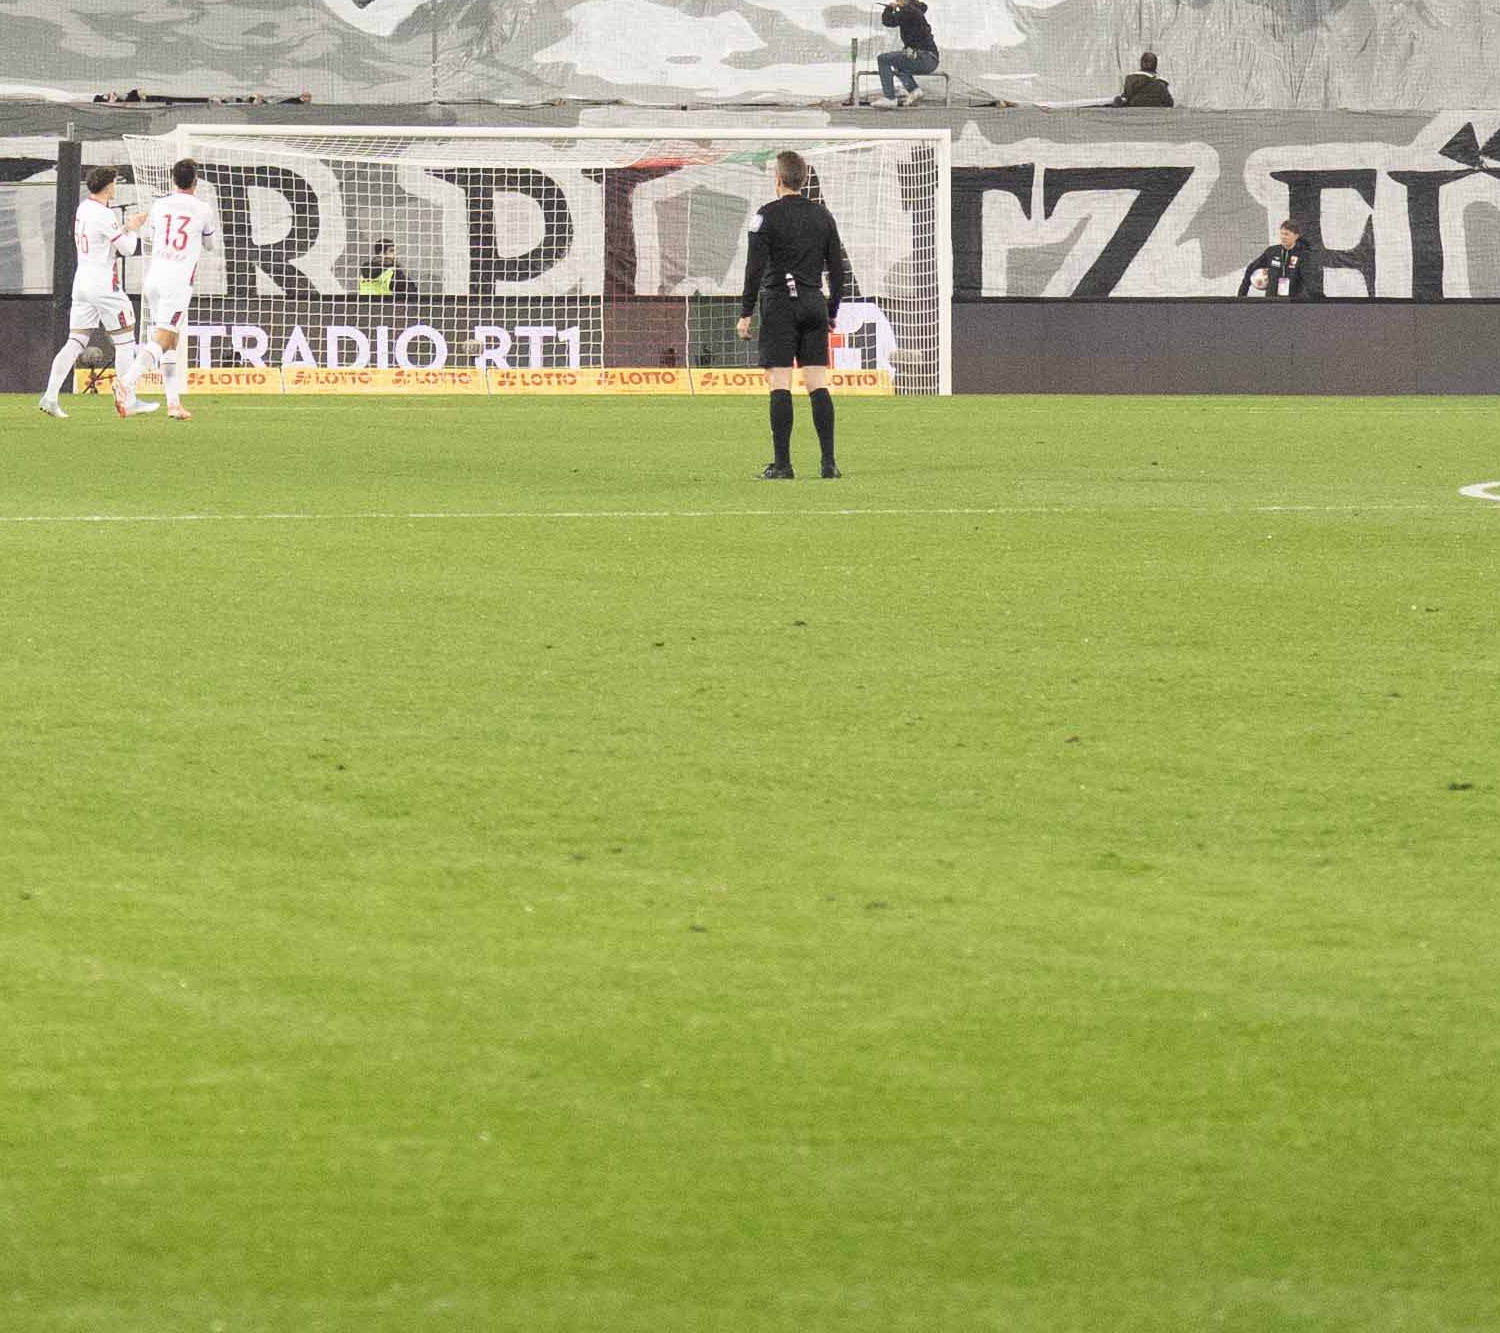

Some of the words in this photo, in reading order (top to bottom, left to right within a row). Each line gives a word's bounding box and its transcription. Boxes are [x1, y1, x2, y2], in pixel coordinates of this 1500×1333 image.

[163, 213, 191, 251] 13
[474, 324, 581, 369] RT1
[521, 372, 577, 386] LOTTO
[619, 371, 676, 386] LOTTO
[722, 373, 767, 386] LOTT
[829, 373, 877, 386] OTTO
